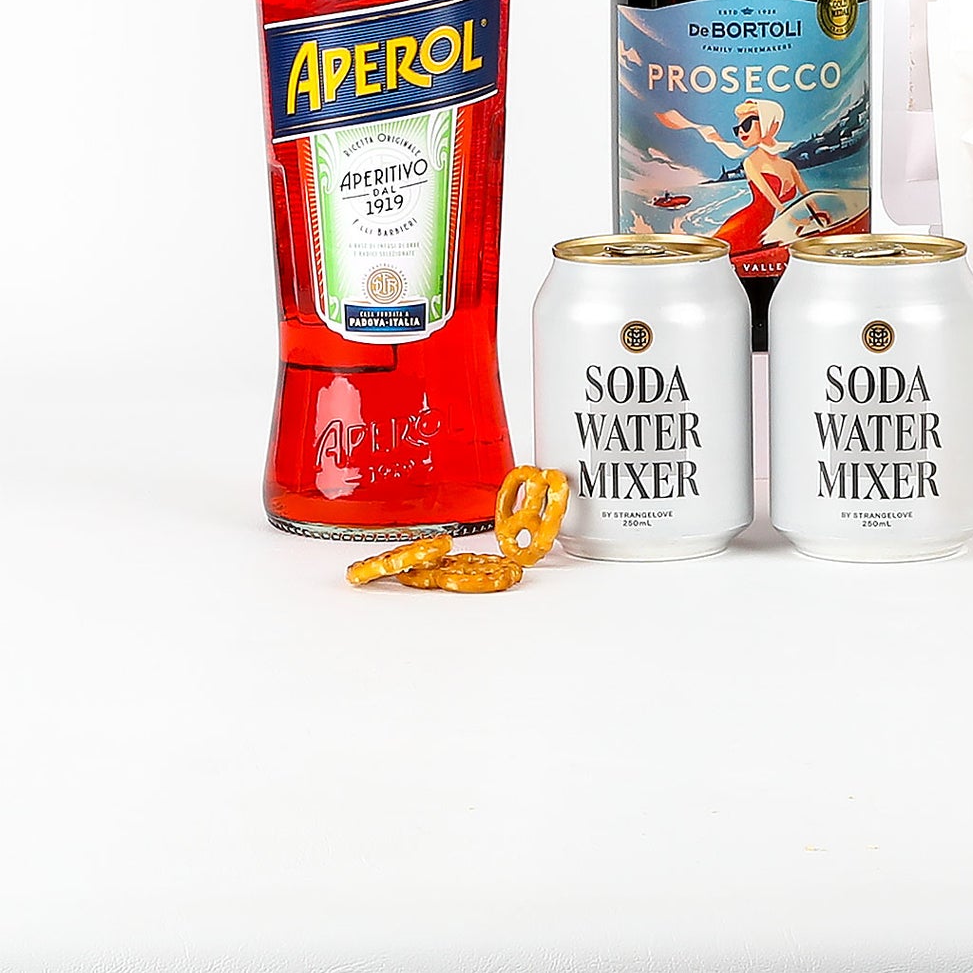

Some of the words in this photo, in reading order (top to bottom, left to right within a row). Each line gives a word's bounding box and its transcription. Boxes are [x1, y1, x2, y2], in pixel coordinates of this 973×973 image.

[702, 44, 733, 53] FAMILY
[737, 43, 792, 54] WINEMAKERS
[286, 18, 484, 116] APEROL
[648, 60, 842, 93] PROSECCO
[339, 158, 428, 192] APERITIVO
[372, 185, 397, 197] DAL
[366, 194, 404, 216] 1919
[585, 364, 691, 404] SODA
[825, 364, 931, 404] SODA
[574, 411, 702, 452] WATER
[814, 411, 942, 452] WATER
[578, 459, 700, 500] MIXER
[818, 459, 940, 500] MIXER
[614, 510, 674, 519] STRANGELOVE
[622, 519, 652, 527] 250mL
[841, 511, 852, 519] BY
[853, 511, 913, 519] STRANGELOVE
[862, 520, 892, 528] 250mL
